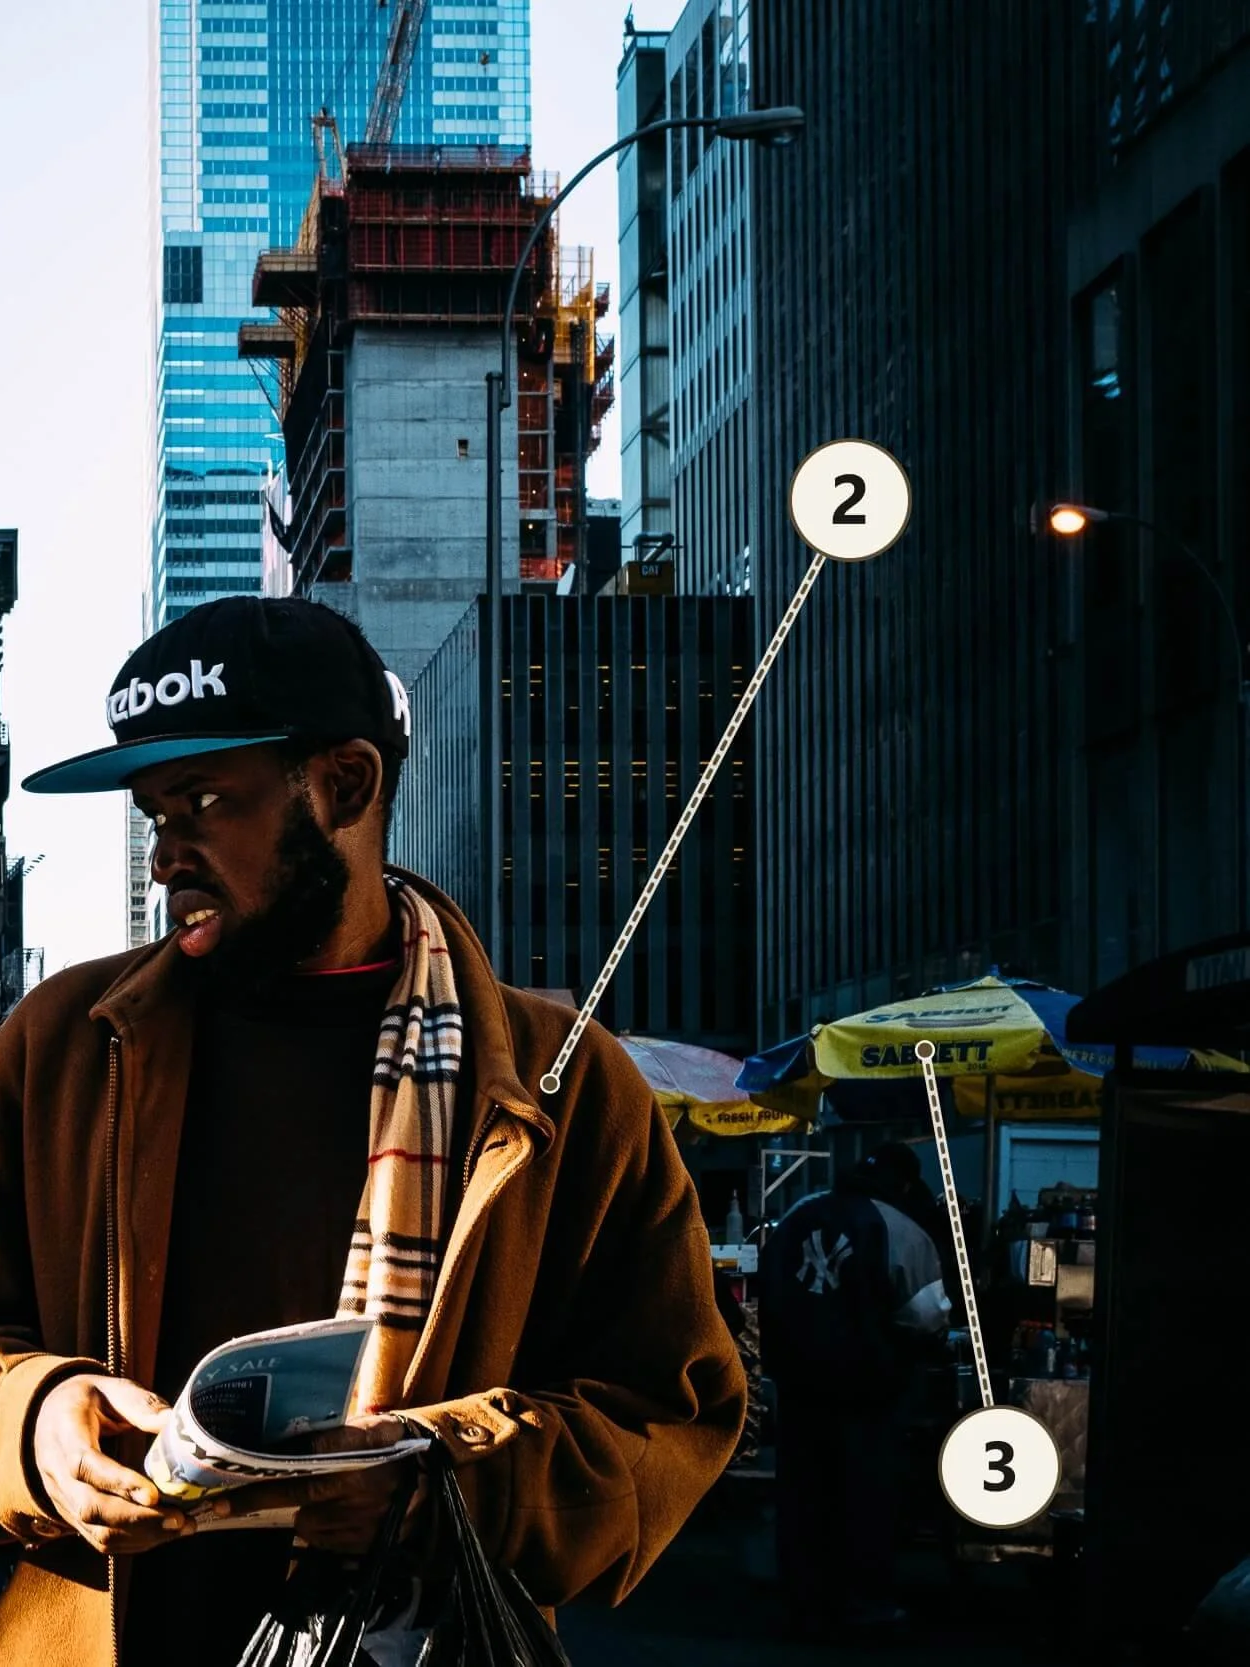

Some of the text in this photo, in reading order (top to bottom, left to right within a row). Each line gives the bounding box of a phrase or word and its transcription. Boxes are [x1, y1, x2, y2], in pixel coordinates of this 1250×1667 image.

[641, 564, 659, 577] CAT
[861, 1039, 993, 1067] SABETT
[717, 1110, 790, 1124] FRESH FRUIT
[228, 1356, 282, 1373] SALE
